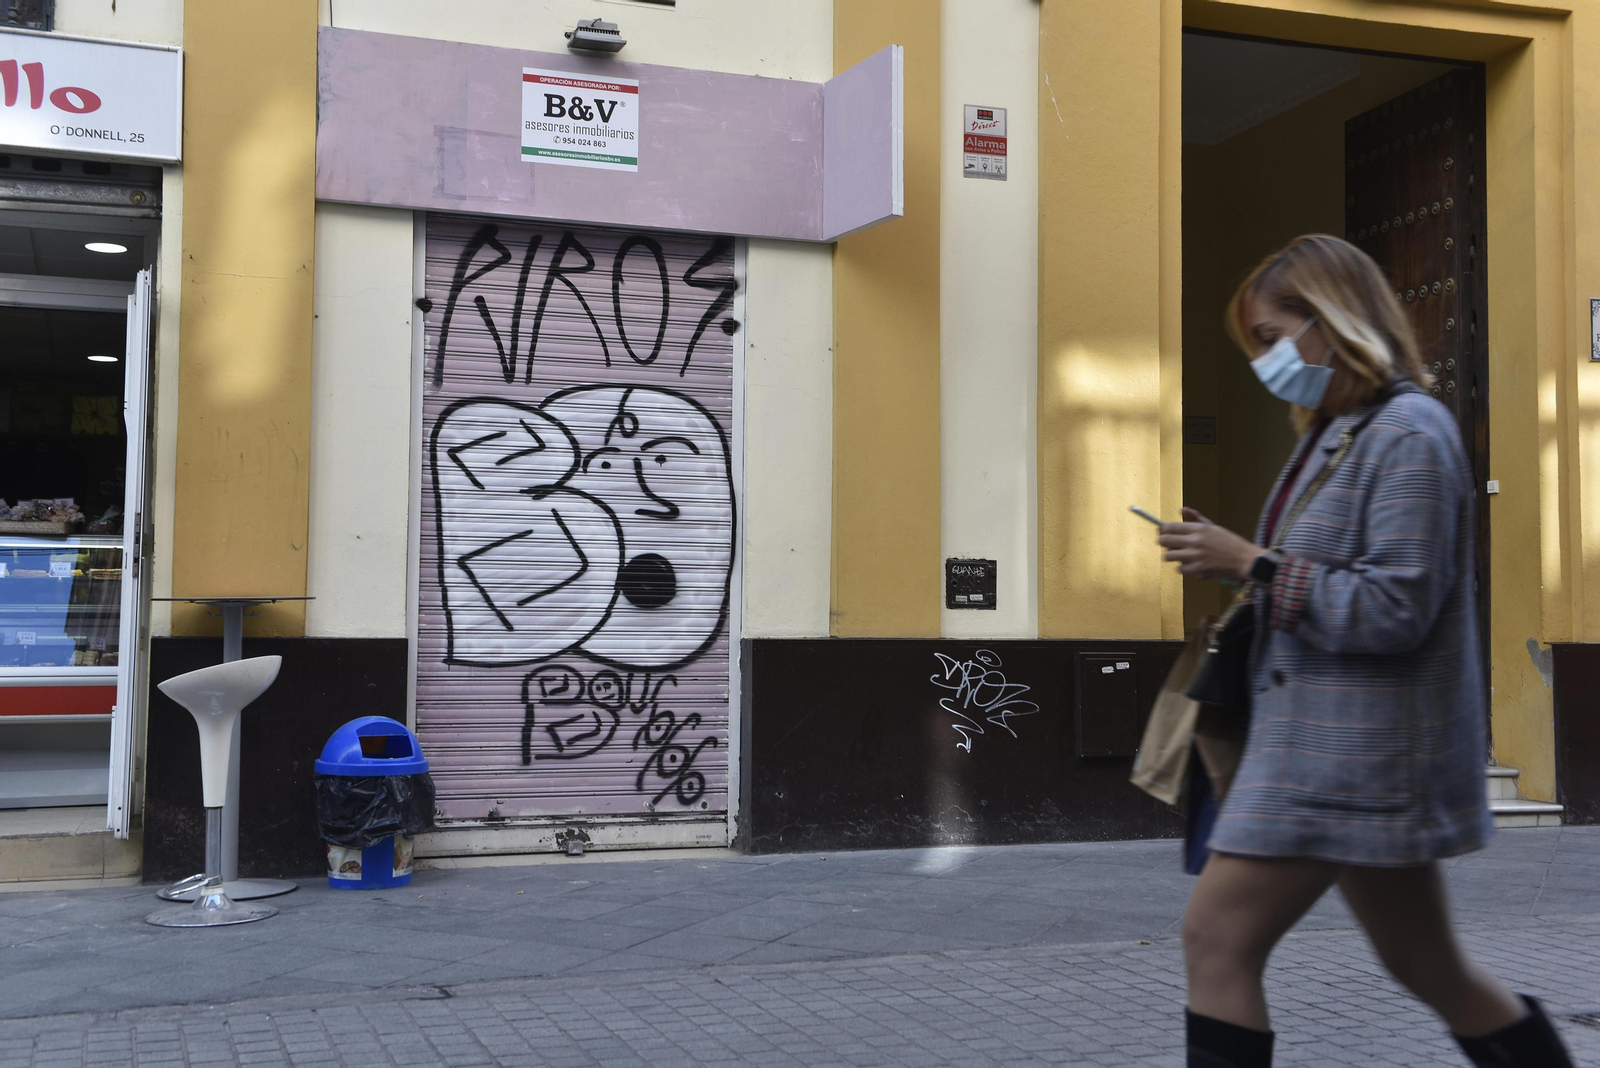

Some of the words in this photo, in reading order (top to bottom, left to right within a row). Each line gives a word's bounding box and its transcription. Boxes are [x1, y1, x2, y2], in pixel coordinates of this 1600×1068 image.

[540, 77, 573, 86] OPERACIÓN
[573, 81, 607, 90] ASESORADA
[525, 121, 570, 134] asesores
[573, 123, 635, 140] inmobiliarios
[129, 133, 145, 143] 25
[562, 137, 576, 145] 954
[593, 140, 607, 148] 863
[965, 137, 1005, 149] Alarma
